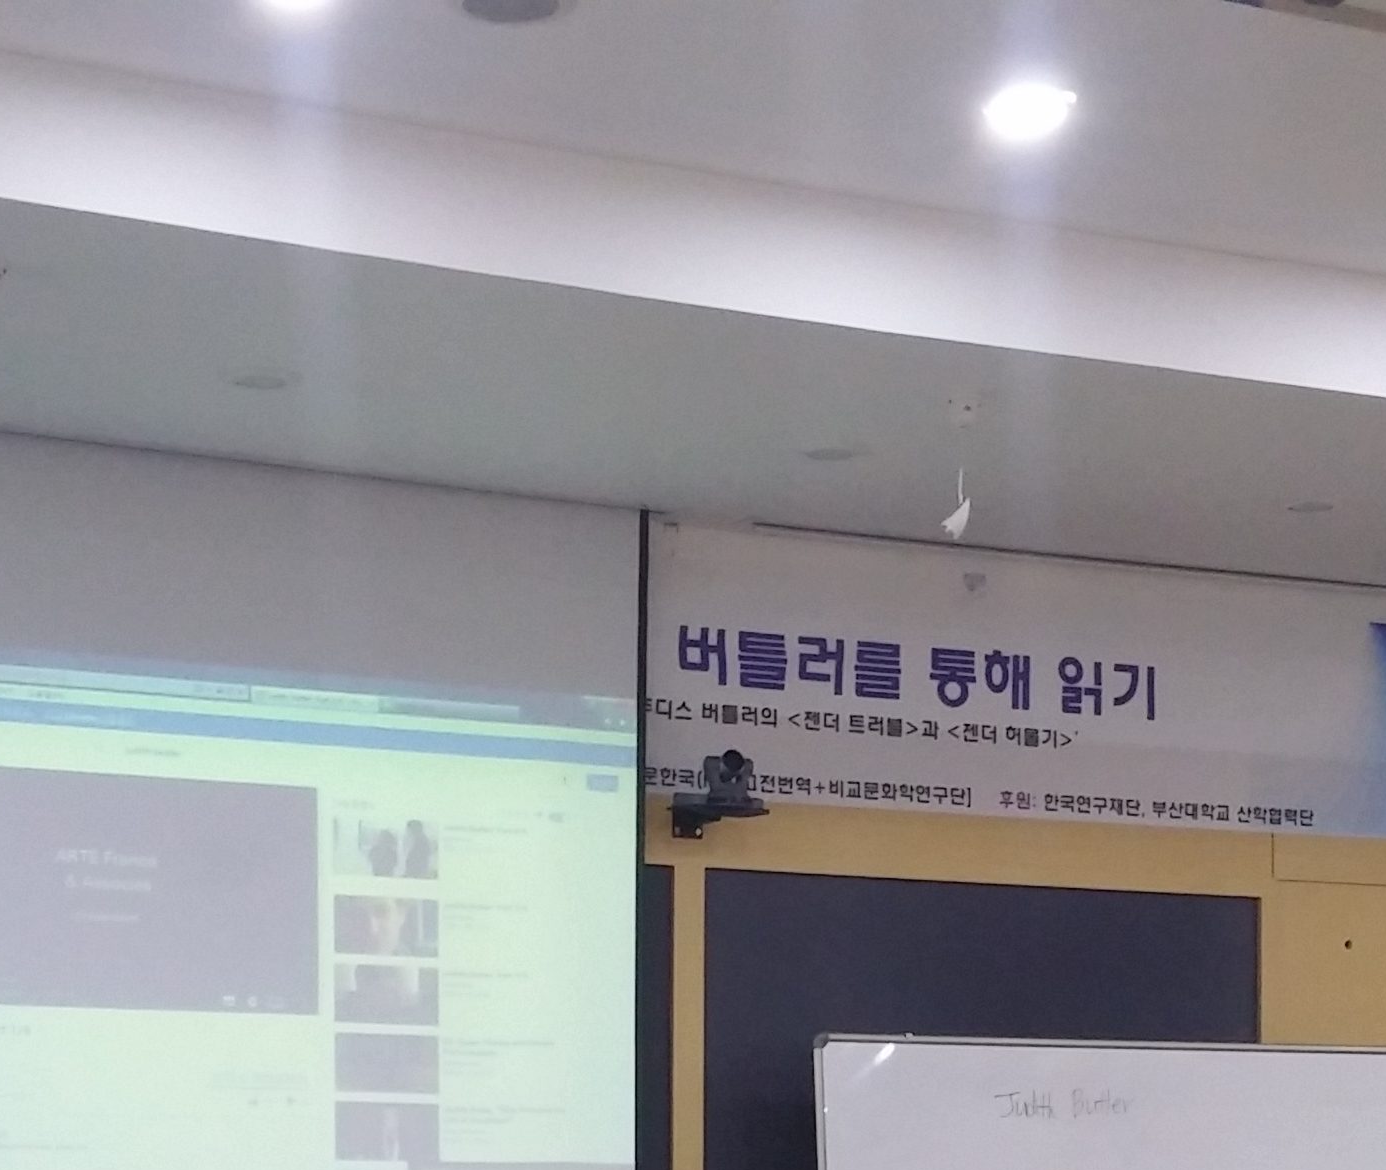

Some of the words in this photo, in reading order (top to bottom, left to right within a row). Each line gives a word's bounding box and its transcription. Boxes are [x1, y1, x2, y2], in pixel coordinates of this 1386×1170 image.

[678, 625, 901, 700] 버틀러를
[929, 648, 1030, 710] 통해
[1058, 656, 1155, 720] 읽기
[788, 710, 840, 732] <젠더
[948, 723, 998, 744] <젠더
[999, 790, 1037, 810] 후원:
[1152, 801, 1230, 821] 부산대학교
[1236, 805, 1315, 827] 산학협력단
